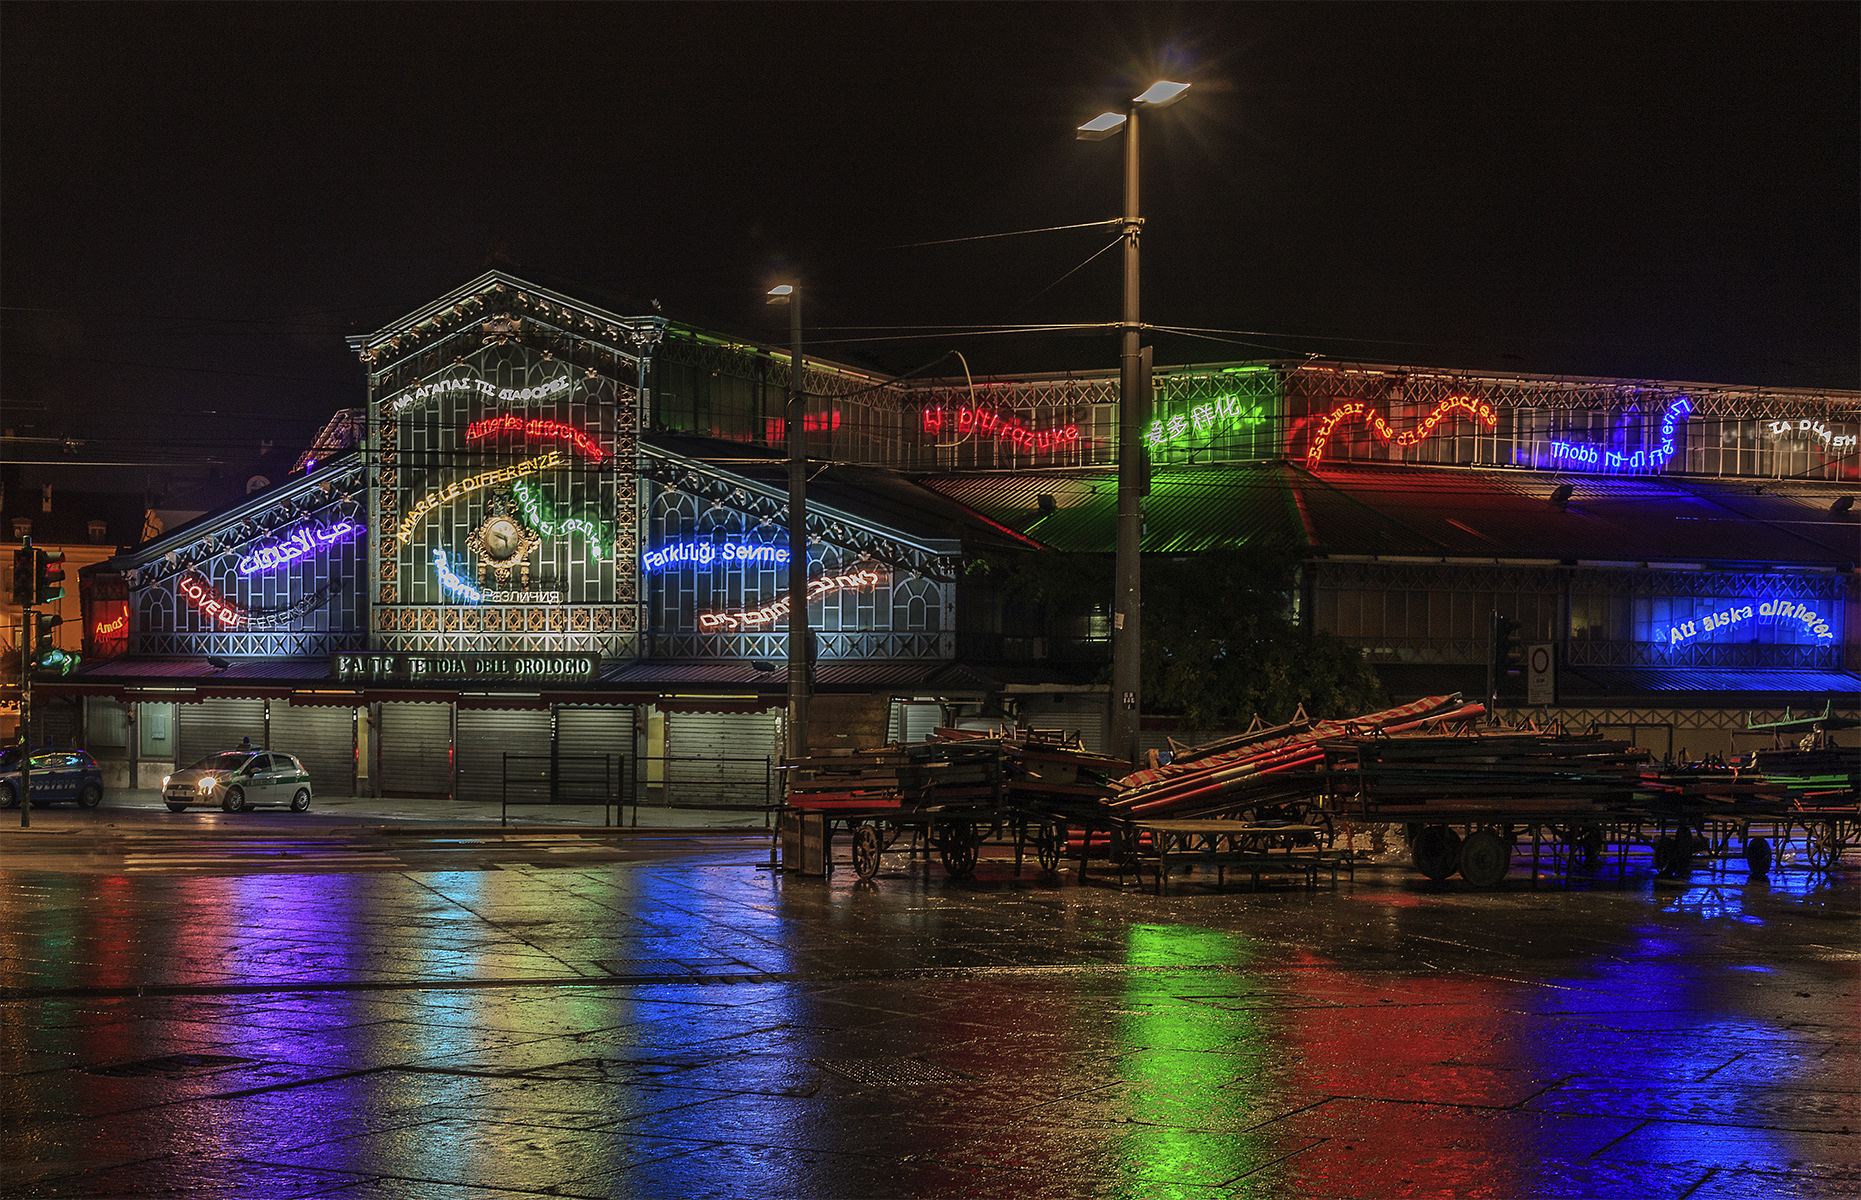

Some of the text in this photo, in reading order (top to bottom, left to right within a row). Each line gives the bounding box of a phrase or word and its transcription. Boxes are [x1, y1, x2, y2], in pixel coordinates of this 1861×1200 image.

[396, 450, 560, 545] AMARE LE DIFFERENZE
[722, 542, 790, 564] Sevme
[180, 577, 221, 616] LOVE
